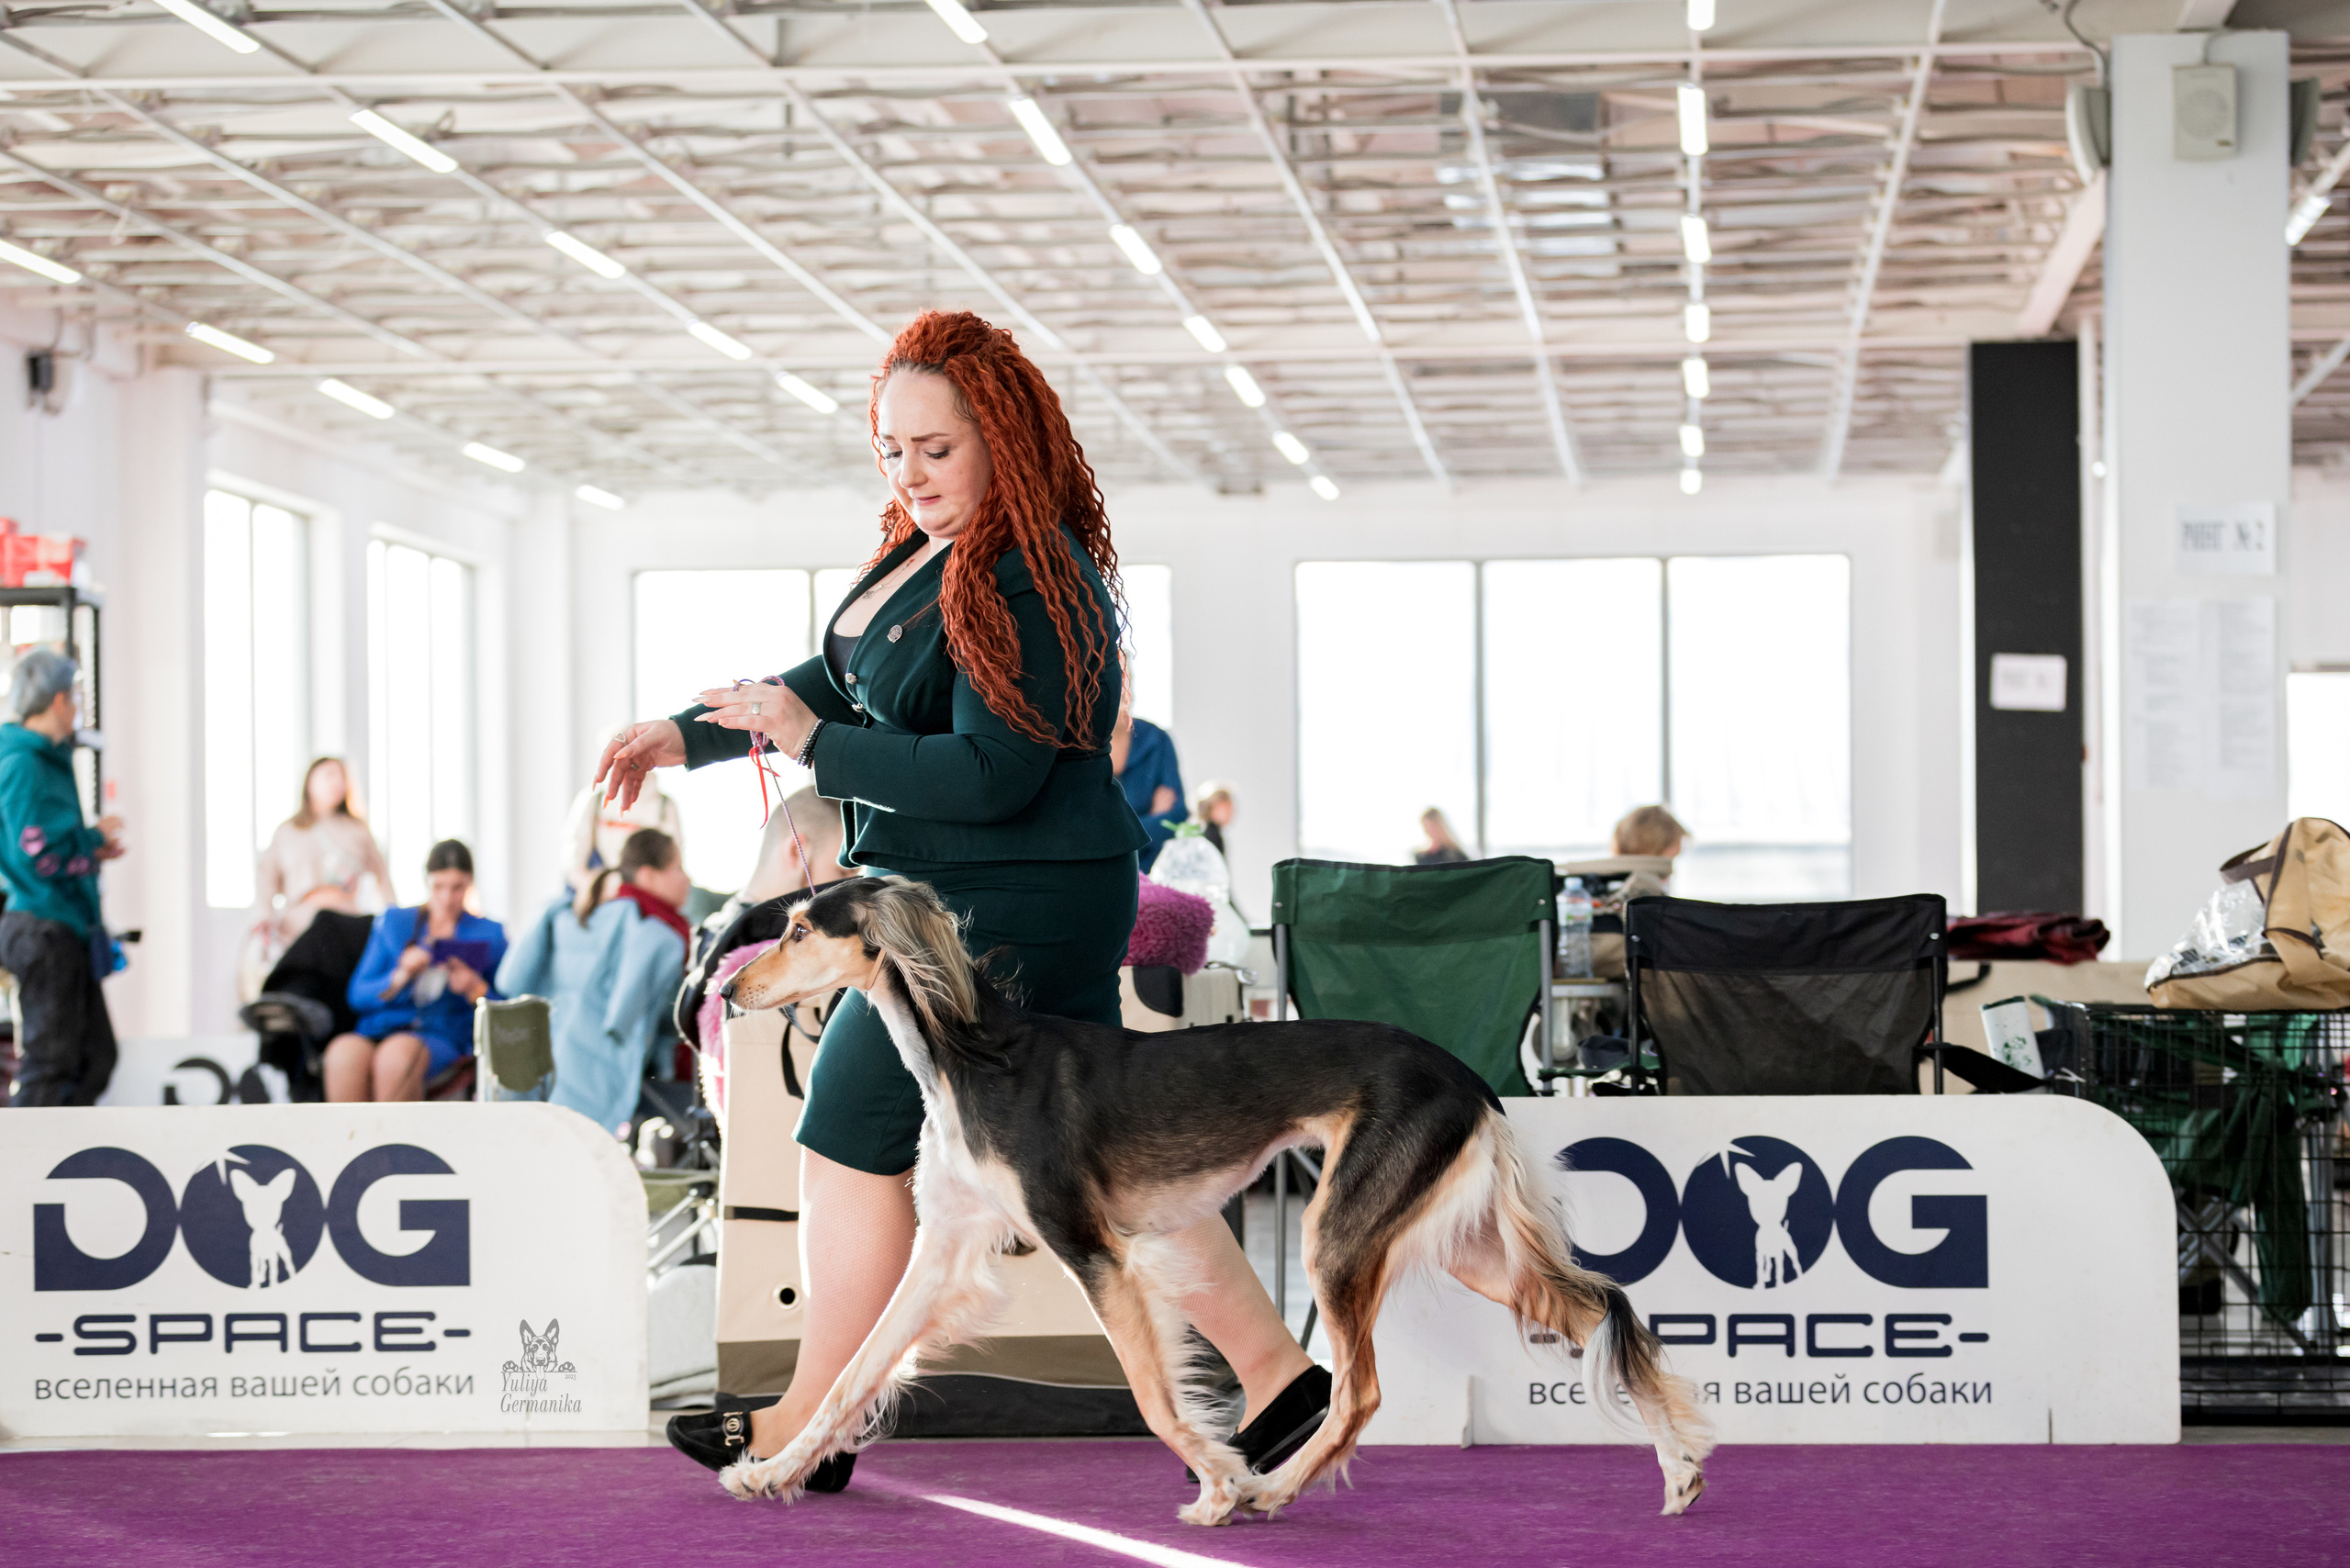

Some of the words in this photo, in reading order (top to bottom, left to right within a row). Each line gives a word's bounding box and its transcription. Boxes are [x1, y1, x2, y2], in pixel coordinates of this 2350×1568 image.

[33, 1143, 471, 1292] DOG
[35, 1376, 217, 1400] вселенная
[231, 1370, 341, 1398] вашей
[353, 1366, 474, 1396] собаки
[1735, 1373, 1851, 1405] вашей
[1863, 1372, 1992, 1405] собаки
